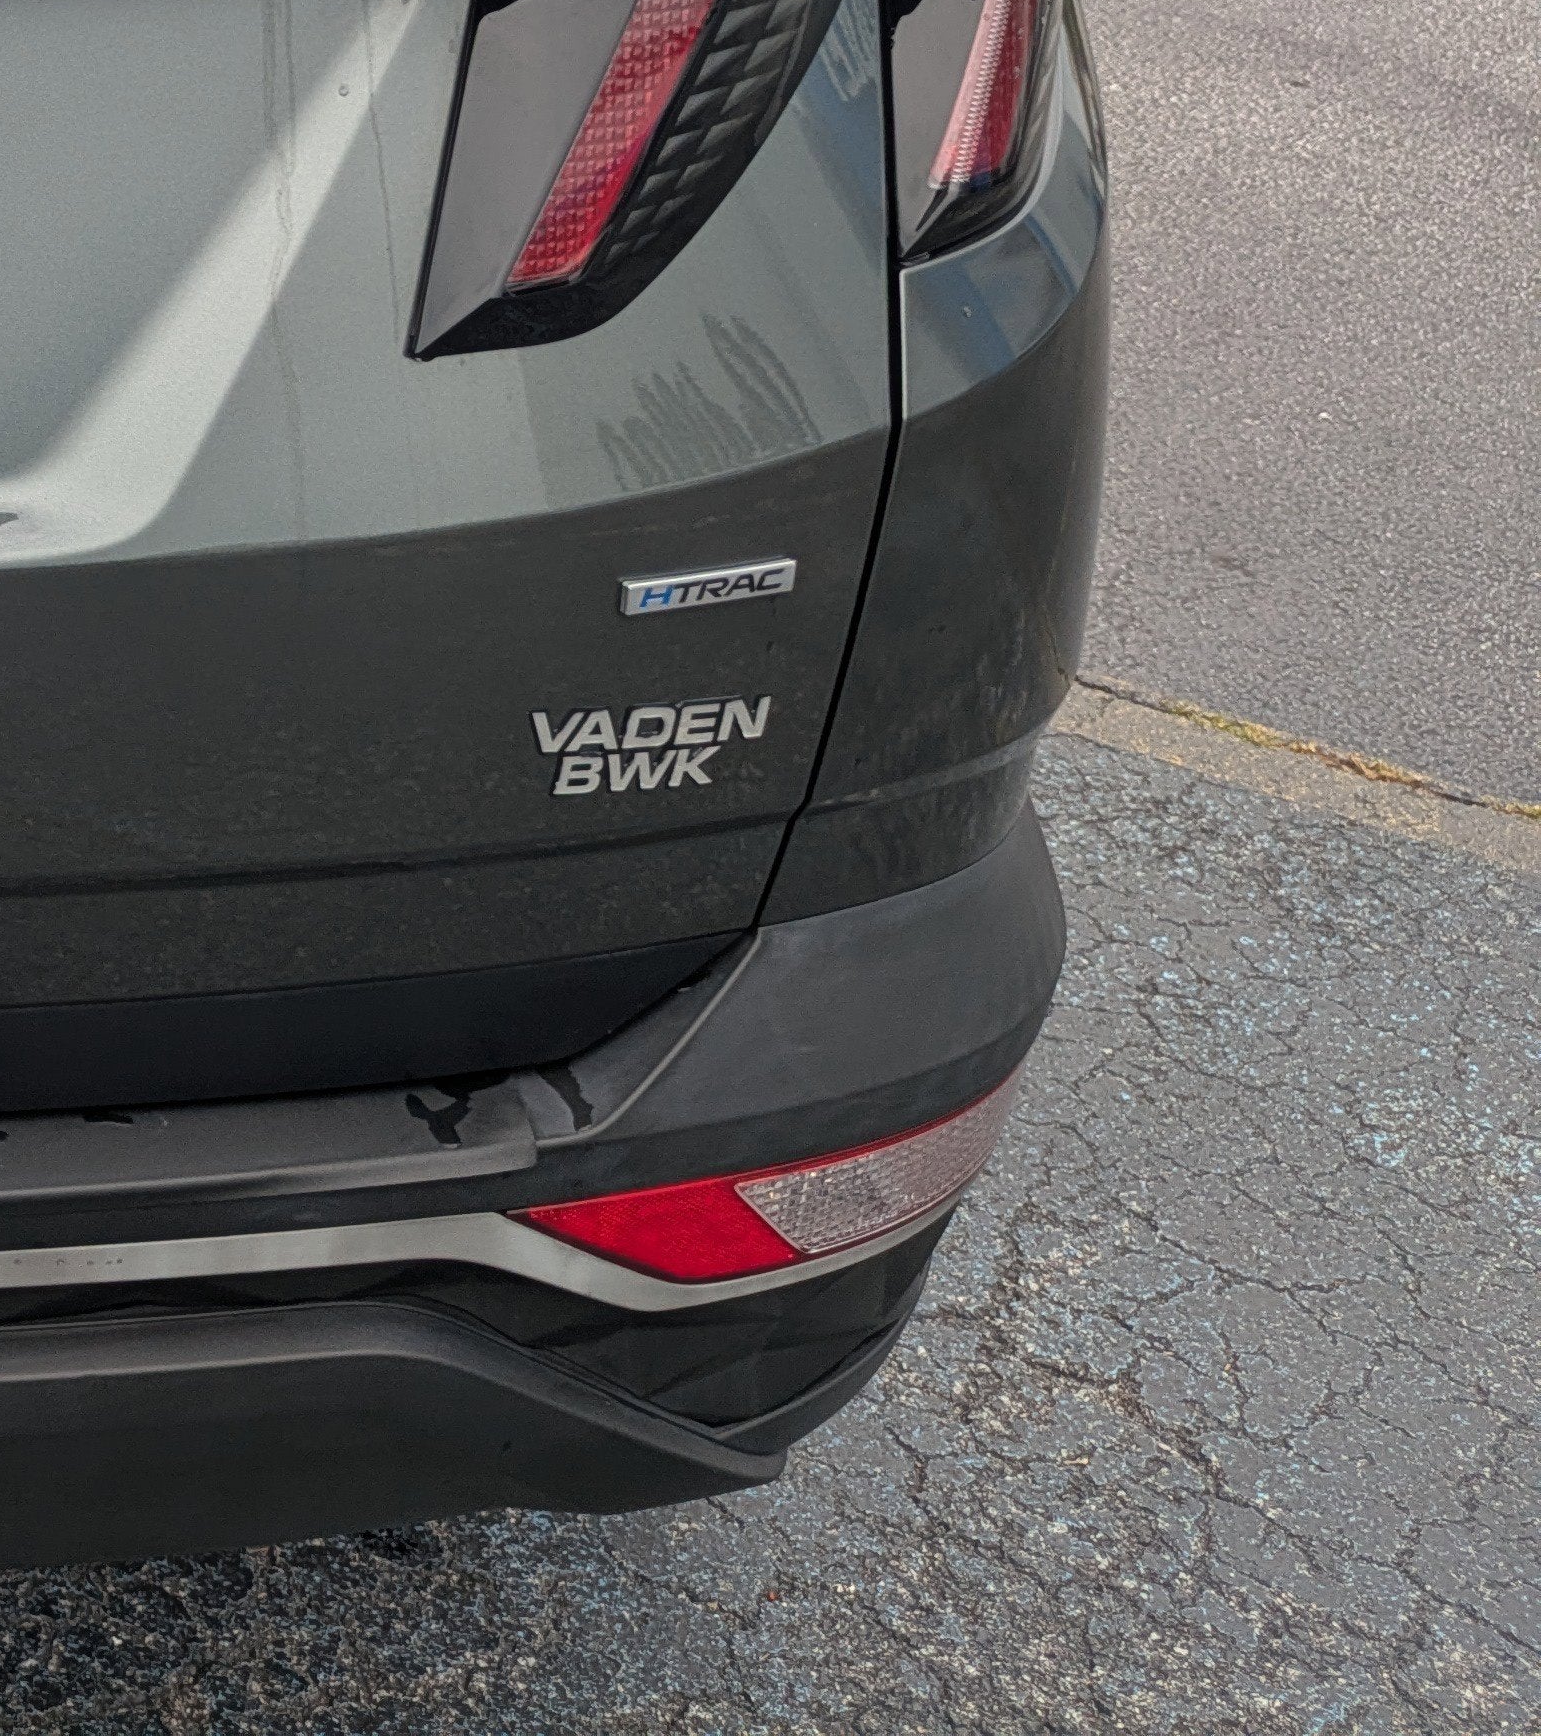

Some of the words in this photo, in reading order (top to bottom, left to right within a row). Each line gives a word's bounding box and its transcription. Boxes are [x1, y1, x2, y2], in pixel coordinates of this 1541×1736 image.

[639, 568, 786, 608] HTRAC
[530, 695, 772, 754] VADEN
[552, 746, 721, 796] BWK
